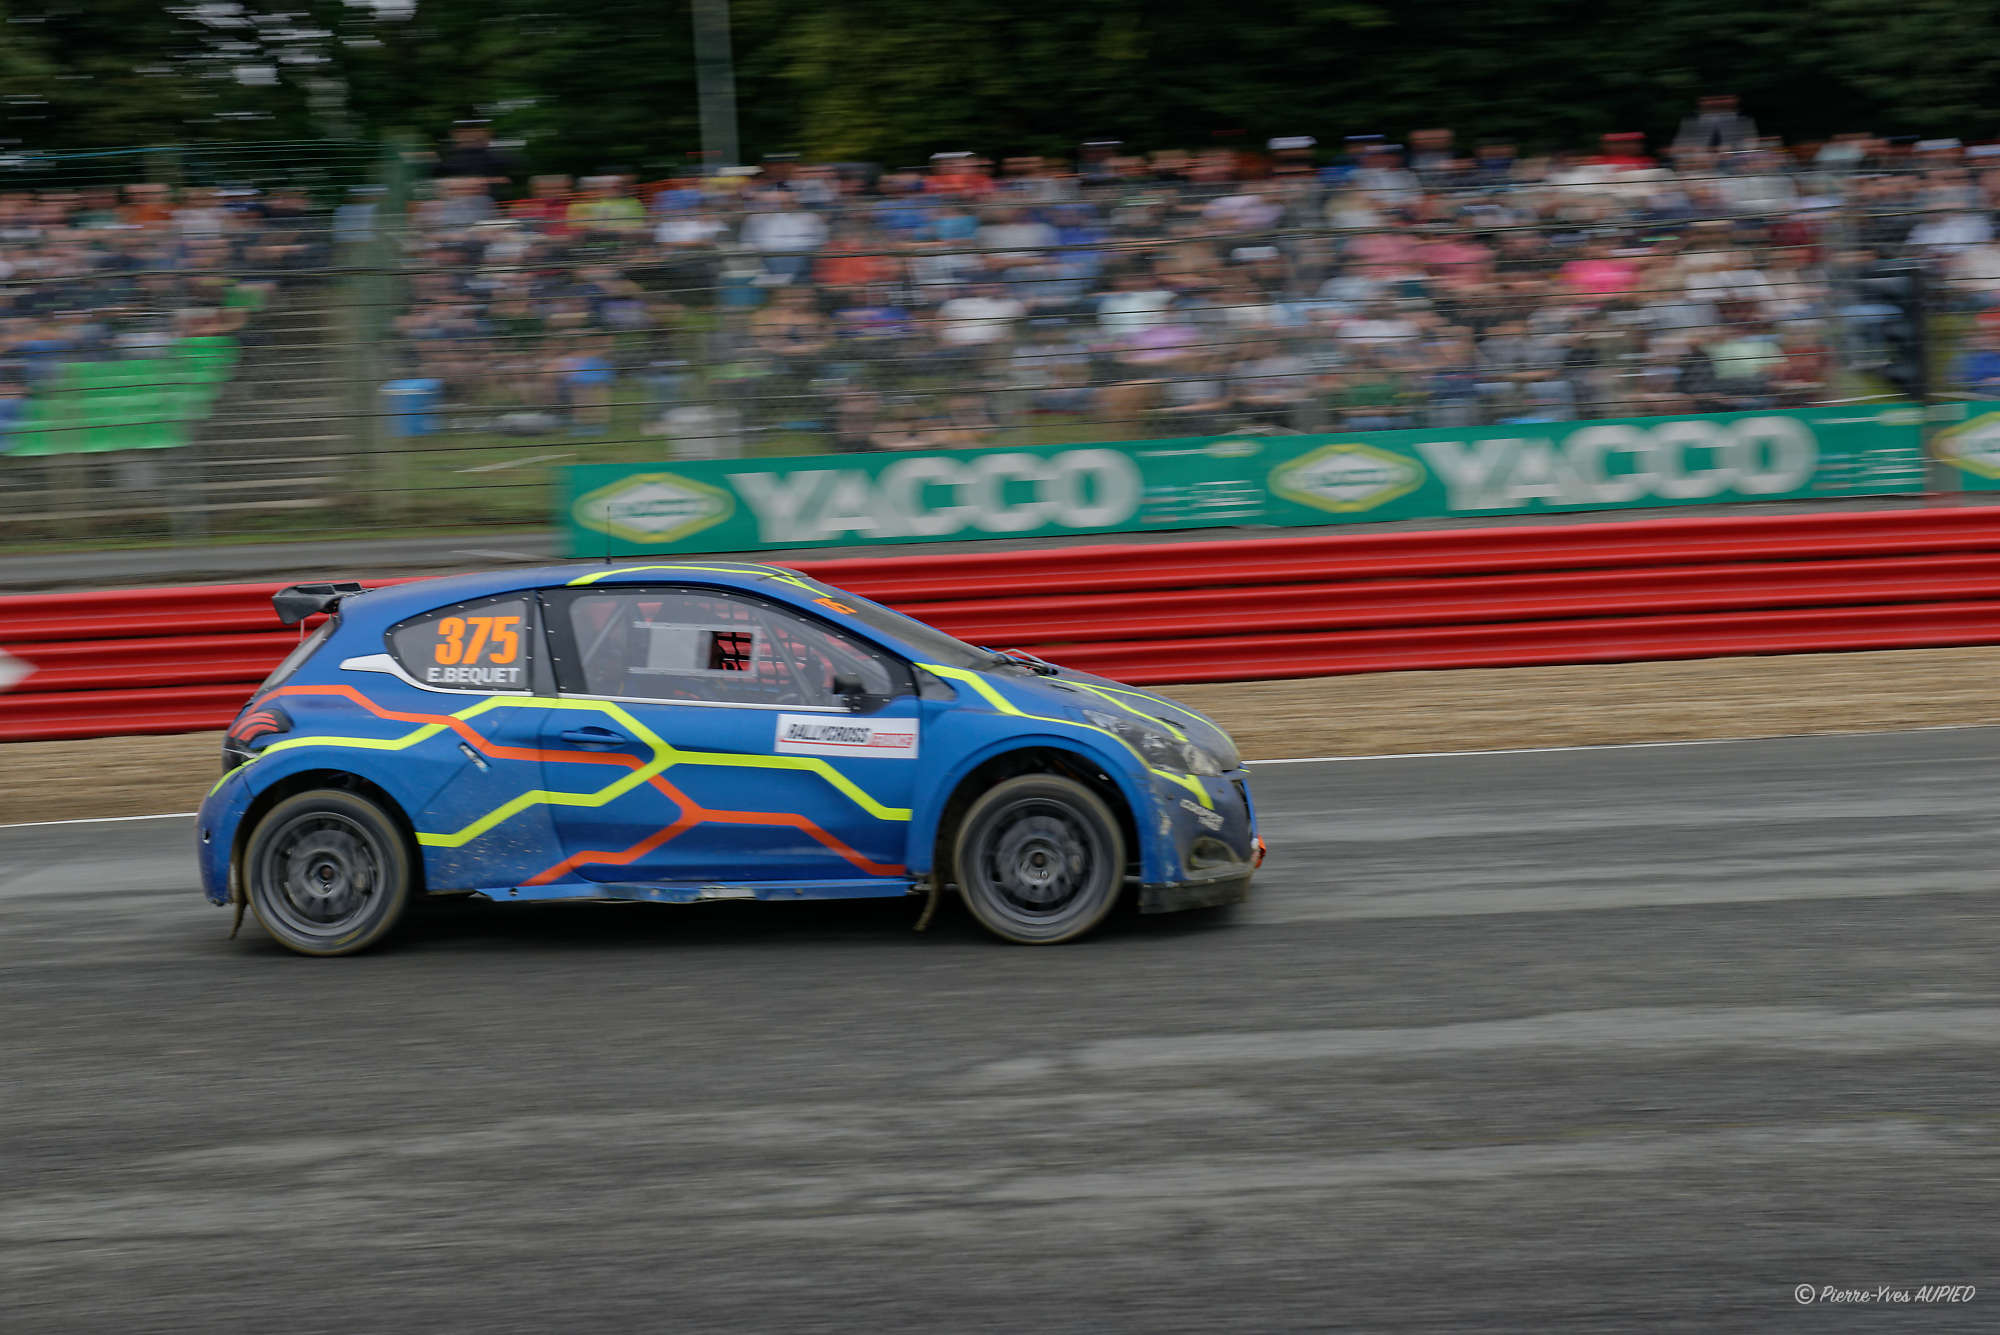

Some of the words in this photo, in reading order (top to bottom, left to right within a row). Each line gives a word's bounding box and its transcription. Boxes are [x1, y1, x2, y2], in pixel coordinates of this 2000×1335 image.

[1413, 415, 1819, 511] YACCO
[726, 448, 1143, 544] YACCO
[434, 616, 521, 666] 375
[427, 667, 521, 686] E.BEQUET
[784, 723, 871, 743] RALLYCROSS
